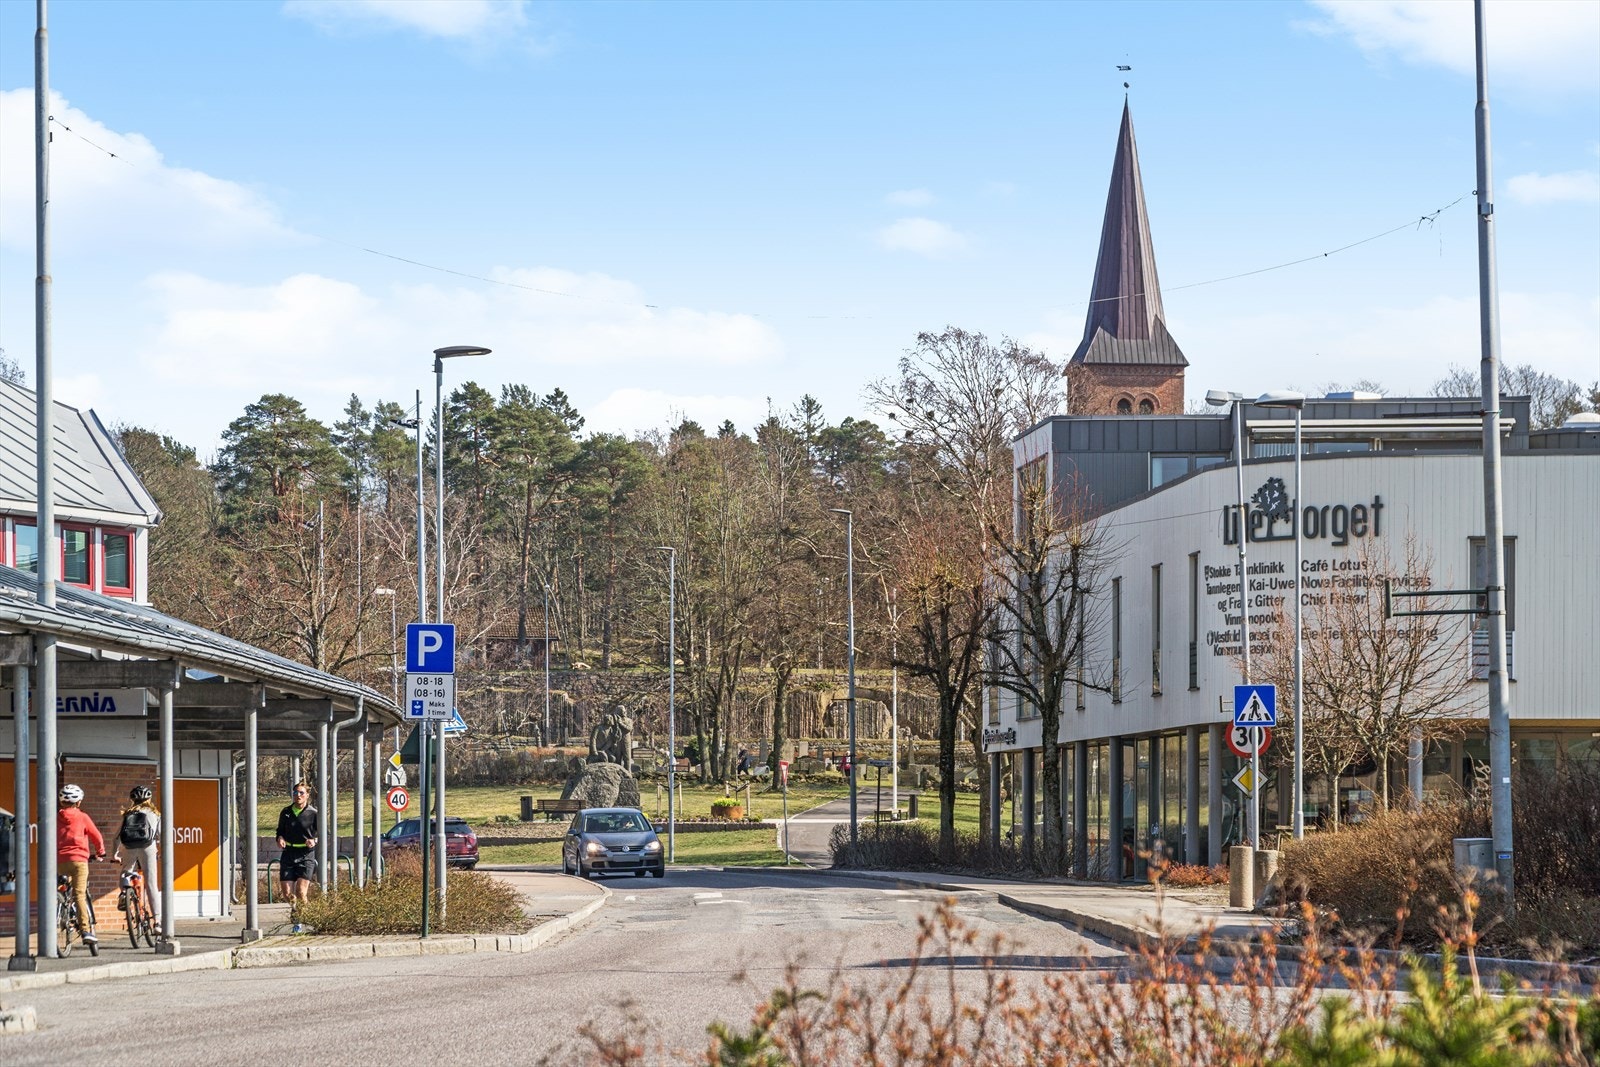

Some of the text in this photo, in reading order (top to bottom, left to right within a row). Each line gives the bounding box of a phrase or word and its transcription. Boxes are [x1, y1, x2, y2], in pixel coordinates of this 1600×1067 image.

[1209, 561, 1285, 579] Stokke Tnklinikk
[1301, 558, 1368, 572] Café Lotus
[1206, 577, 1295, 596] Tannlegen Kai-Uwe
[1217, 594, 1286, 613] og Fraz Gitter
[1301, 593, 1326, 606] Chic
[1225, 611, 1284, 626] Vinmnopolet
[417, 630, 443, 667] P
[1213, 644, 1275, 657] Kommunasjon
[1235, 726, 1264, 747] 30
[391, 793, 406, 806] 40
